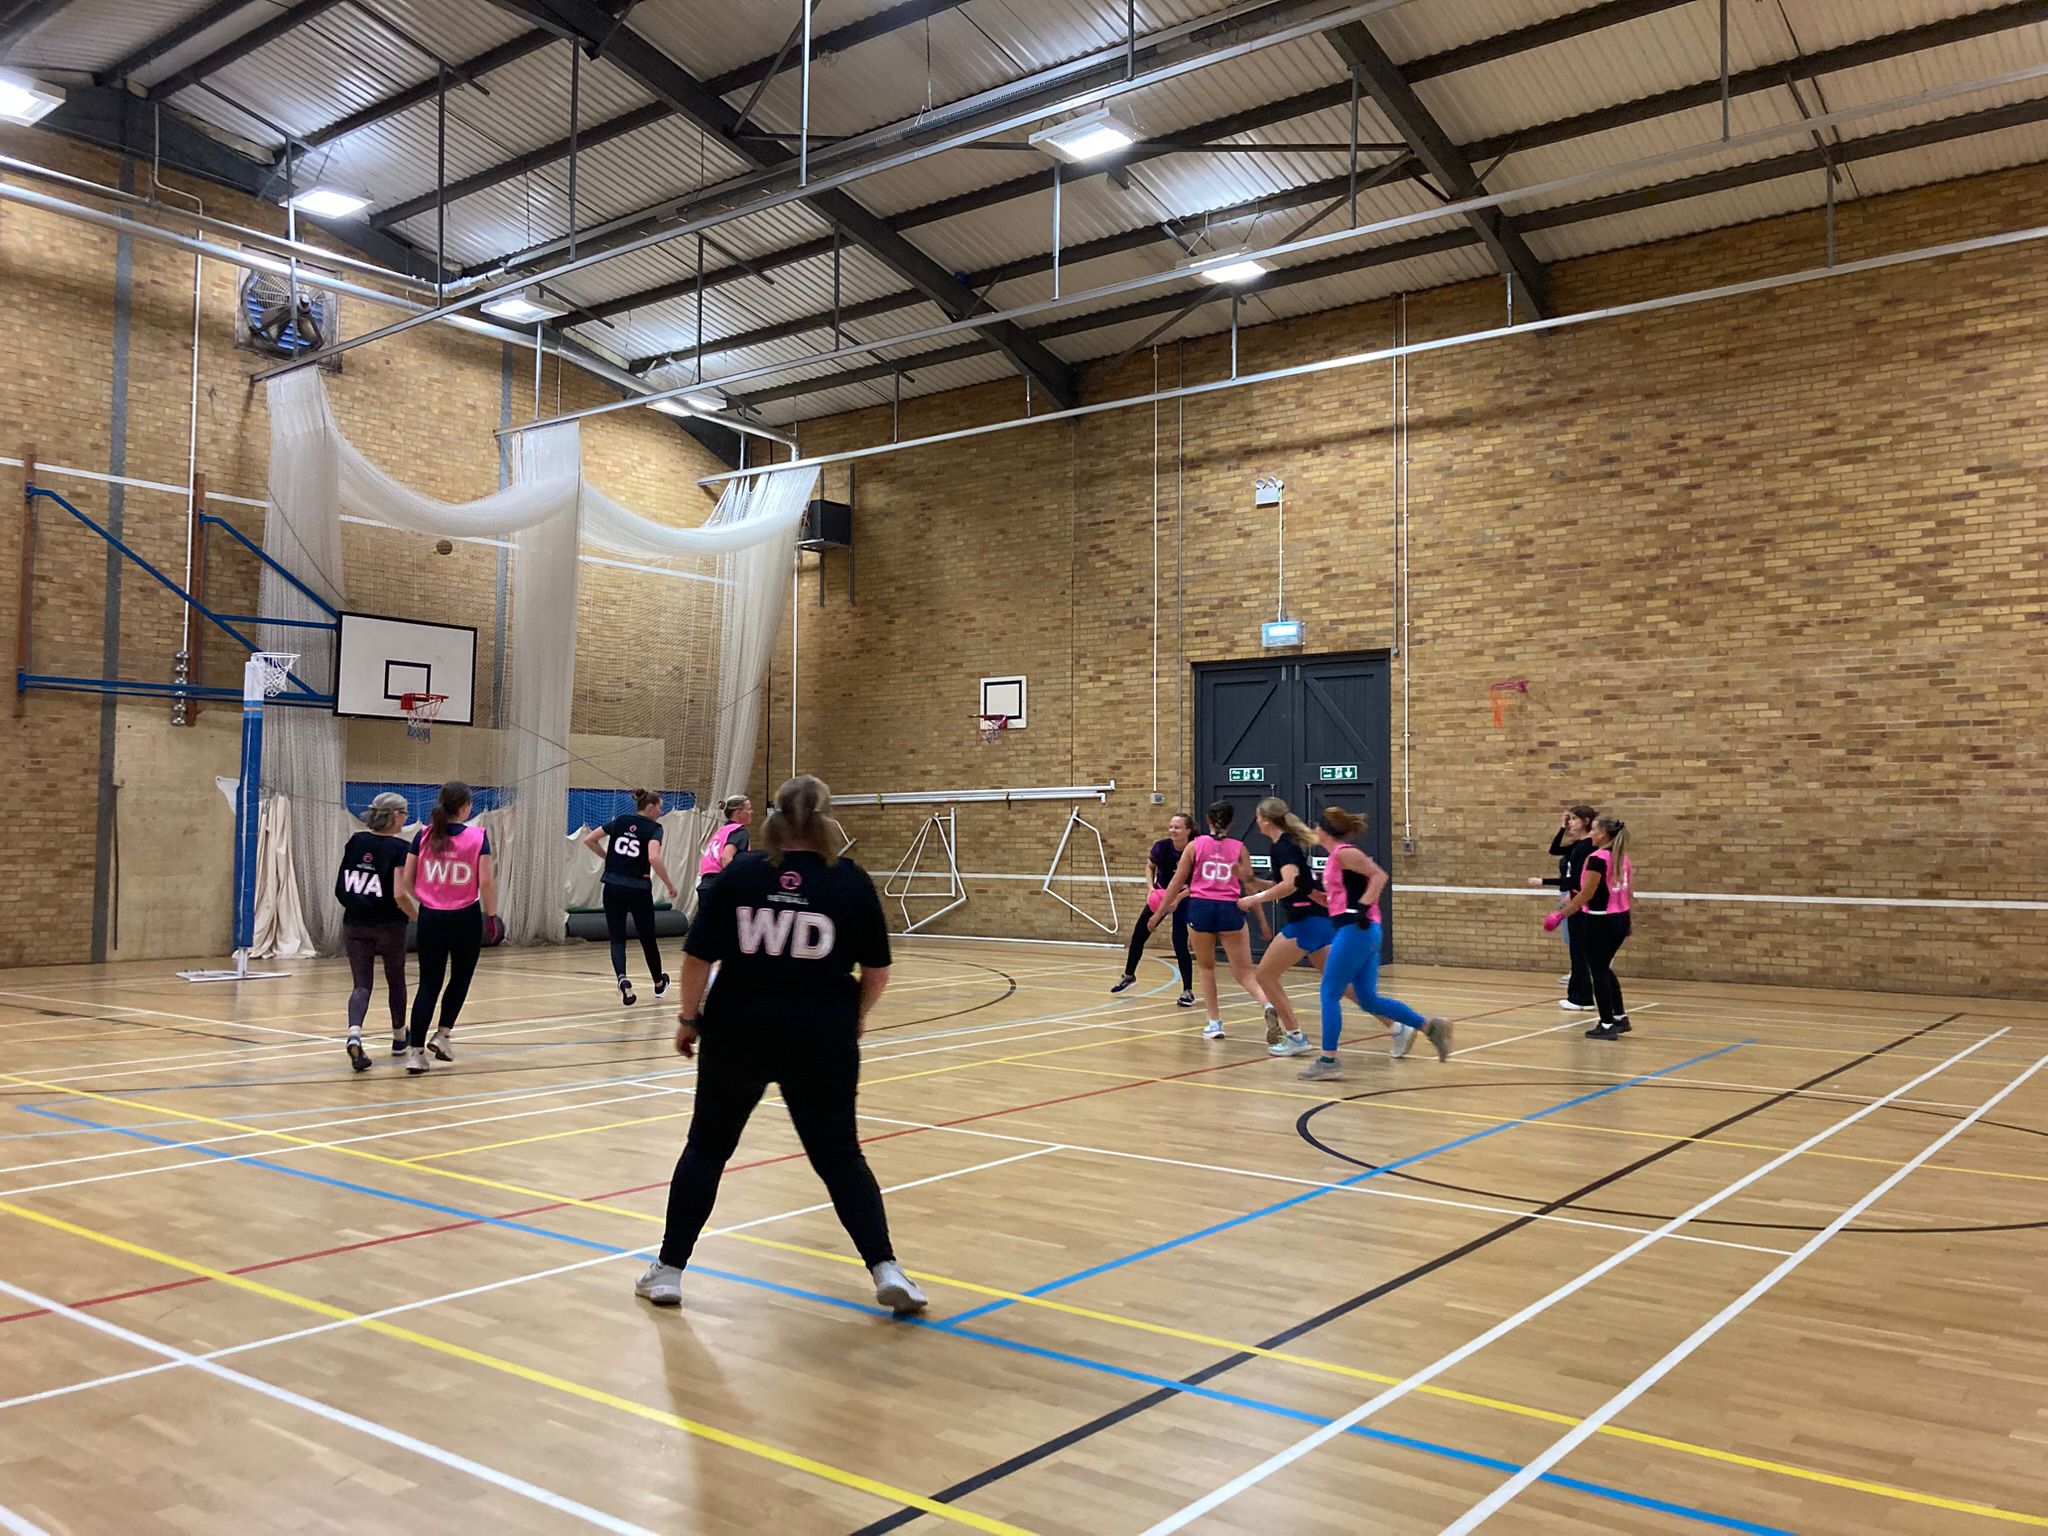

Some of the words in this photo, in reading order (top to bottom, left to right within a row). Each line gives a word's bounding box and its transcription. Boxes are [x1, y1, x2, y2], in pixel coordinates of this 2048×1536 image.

[614, 836, 641, 858] GS
[344, 869, 382, 898] WA
[424, 859, 472, 886] WD
[1202, 861, 1232, 881] GD
[736, 906, 836, 960] WD
